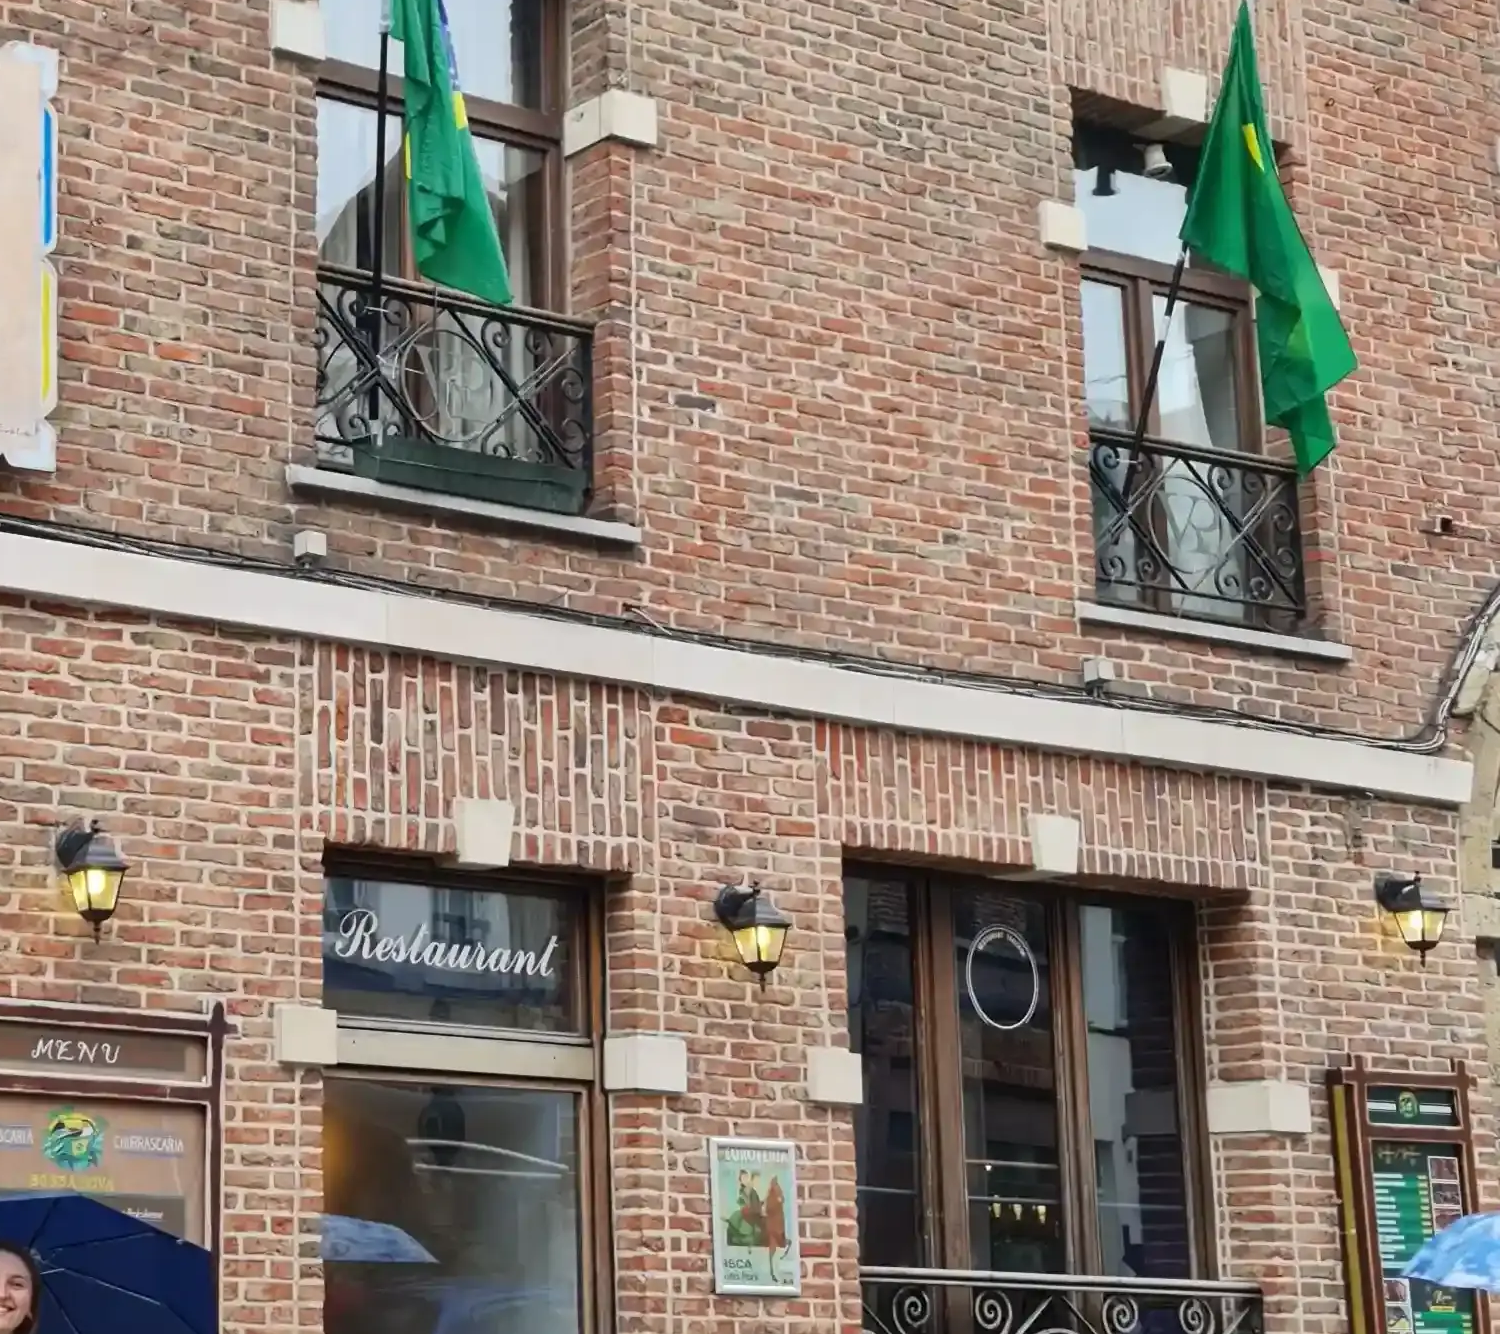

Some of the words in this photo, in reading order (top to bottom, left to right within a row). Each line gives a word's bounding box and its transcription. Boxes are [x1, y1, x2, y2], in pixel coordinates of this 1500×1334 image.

[335, 908, 559, 978] Restaurant
[30, 1038, 121, 1065] MENU
[113, 1135, 185, 1153] CHURRASCARIA
